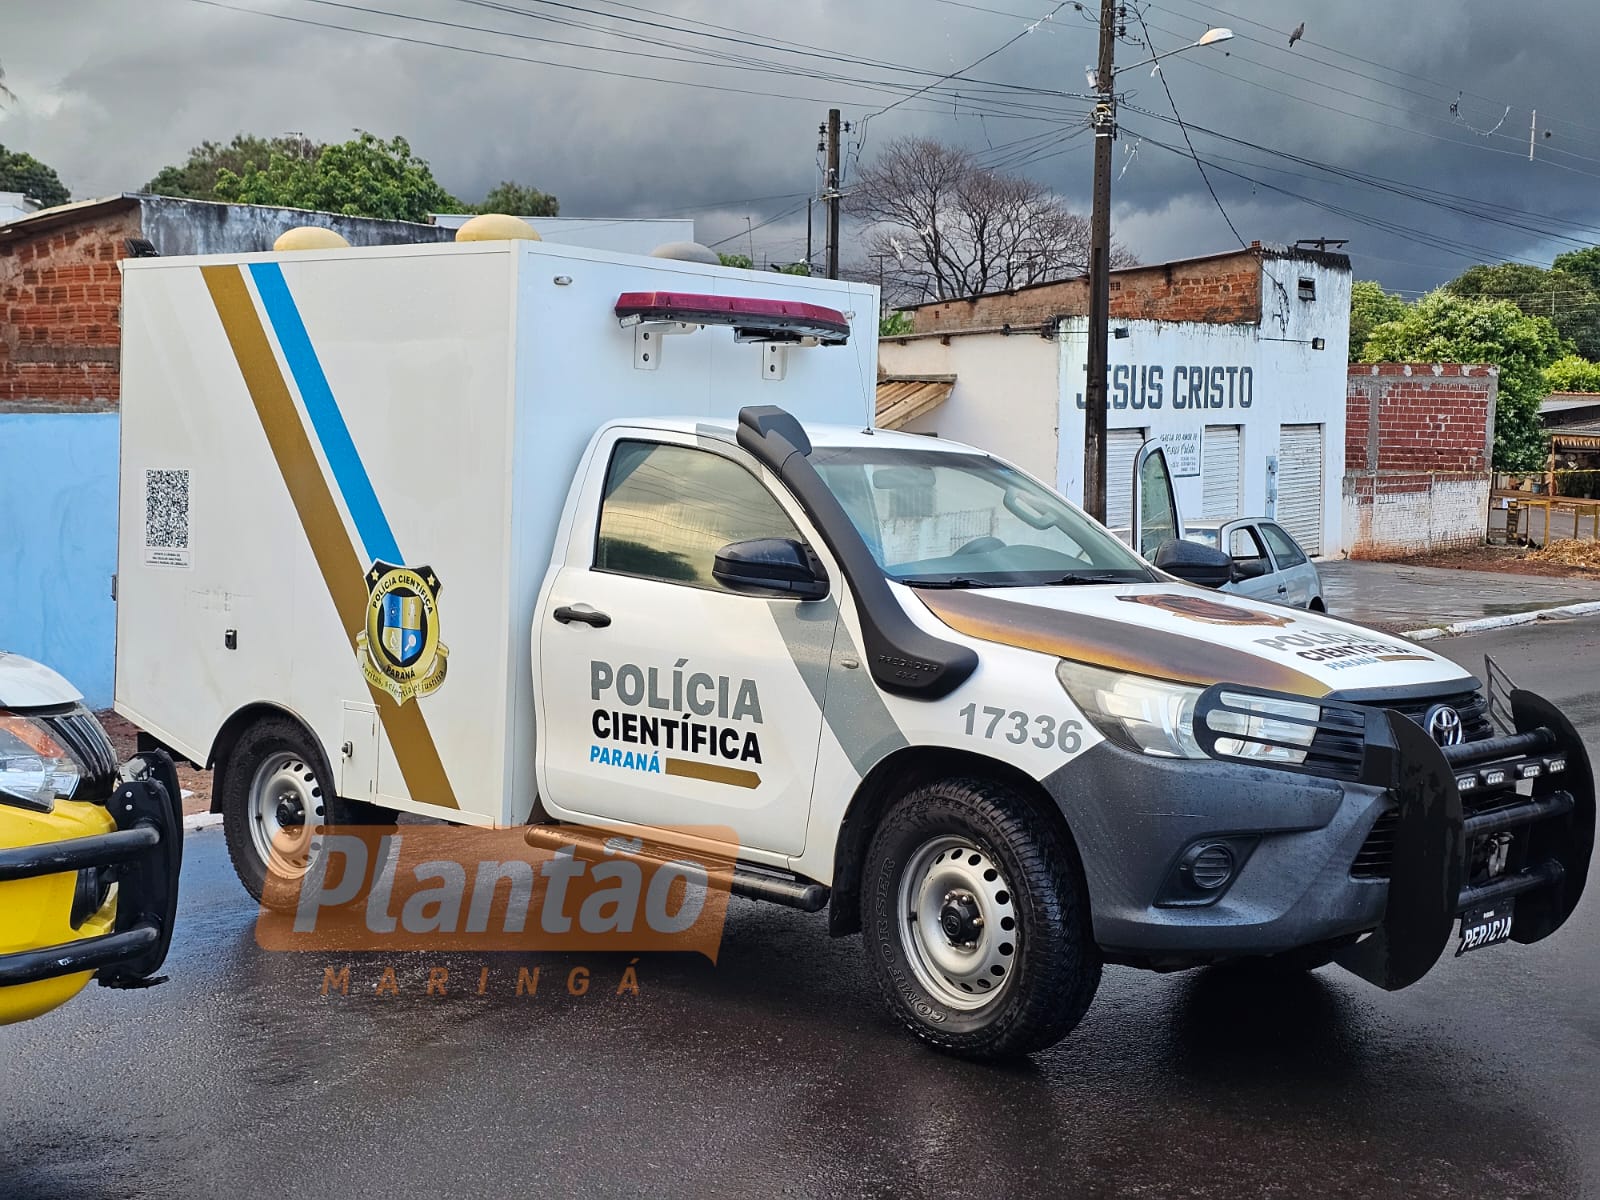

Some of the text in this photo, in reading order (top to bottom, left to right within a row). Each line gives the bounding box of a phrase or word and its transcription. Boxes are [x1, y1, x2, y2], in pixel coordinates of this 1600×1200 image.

[1172, 365, 1253, 409] CRISTO
[372, 574, 433, 614] POLÍCIA CIENTÍFICA
[386, 665, 416, 680] PARANÁ
[591, 658, 764, 724] POLÍCIA
[592, 709, 762, 764] CIENTÍFICA
[959, 703, 1083, 754] 17336
[590, 745, 660, 773] PARANÁ
[1461, 916, 1512, 951] PERICIA
